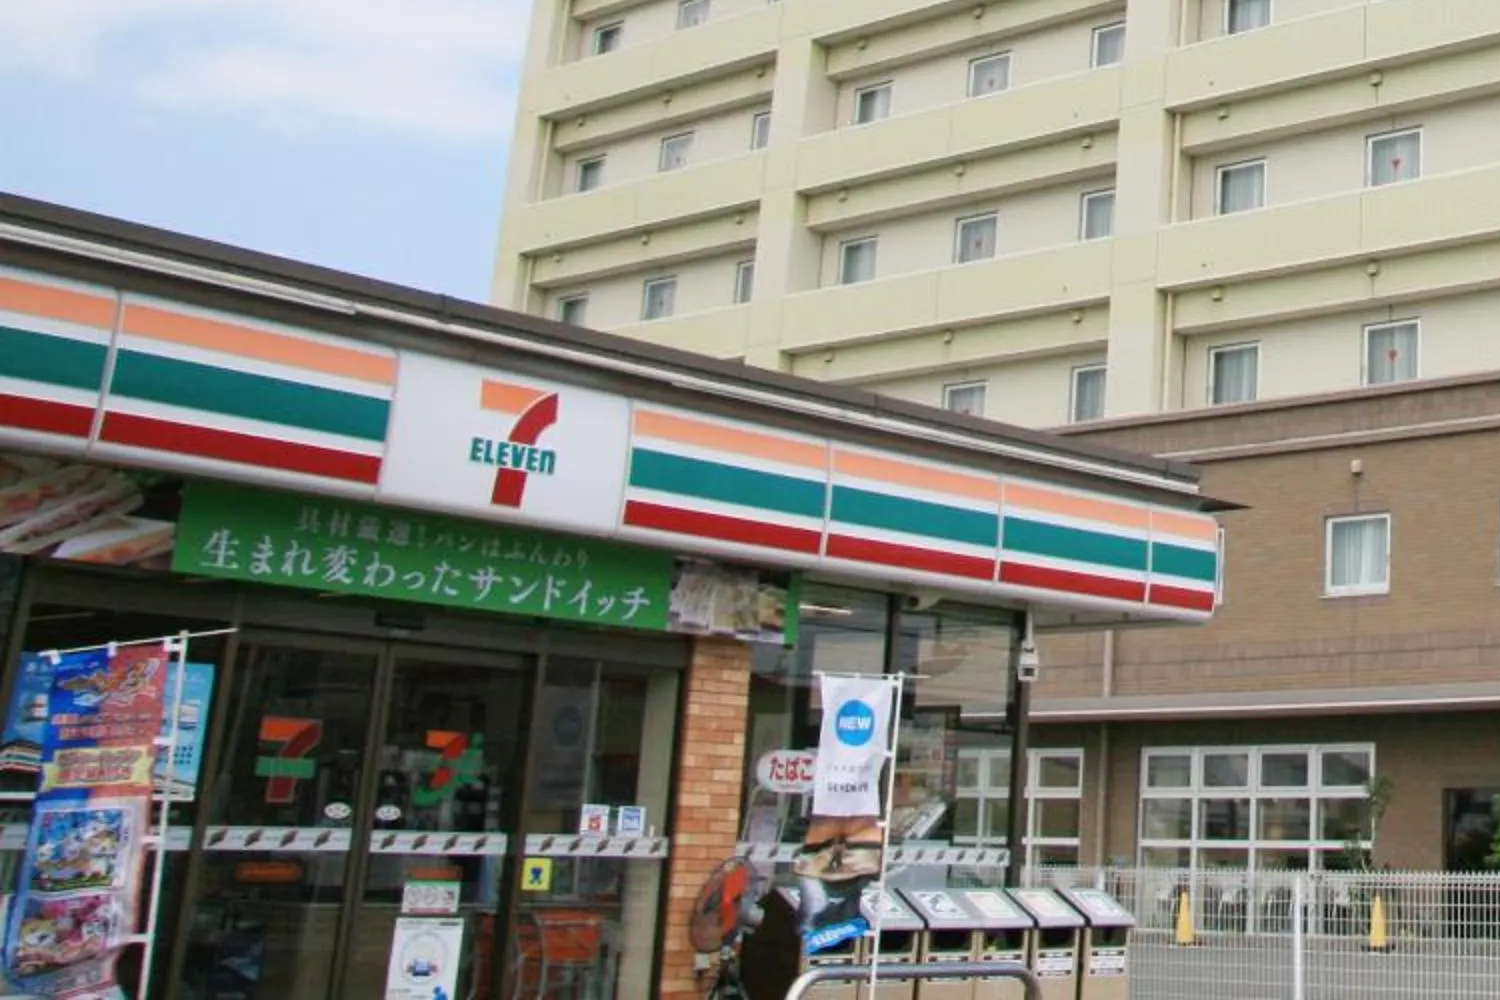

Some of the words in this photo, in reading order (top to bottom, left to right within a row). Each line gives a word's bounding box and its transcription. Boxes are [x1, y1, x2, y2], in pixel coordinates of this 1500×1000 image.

[480, 378, 558, 508] 7
[199, 527, 651, 621] 生まれ変わったサンドイッチ
[769, 755, 813, 781] たばこ
